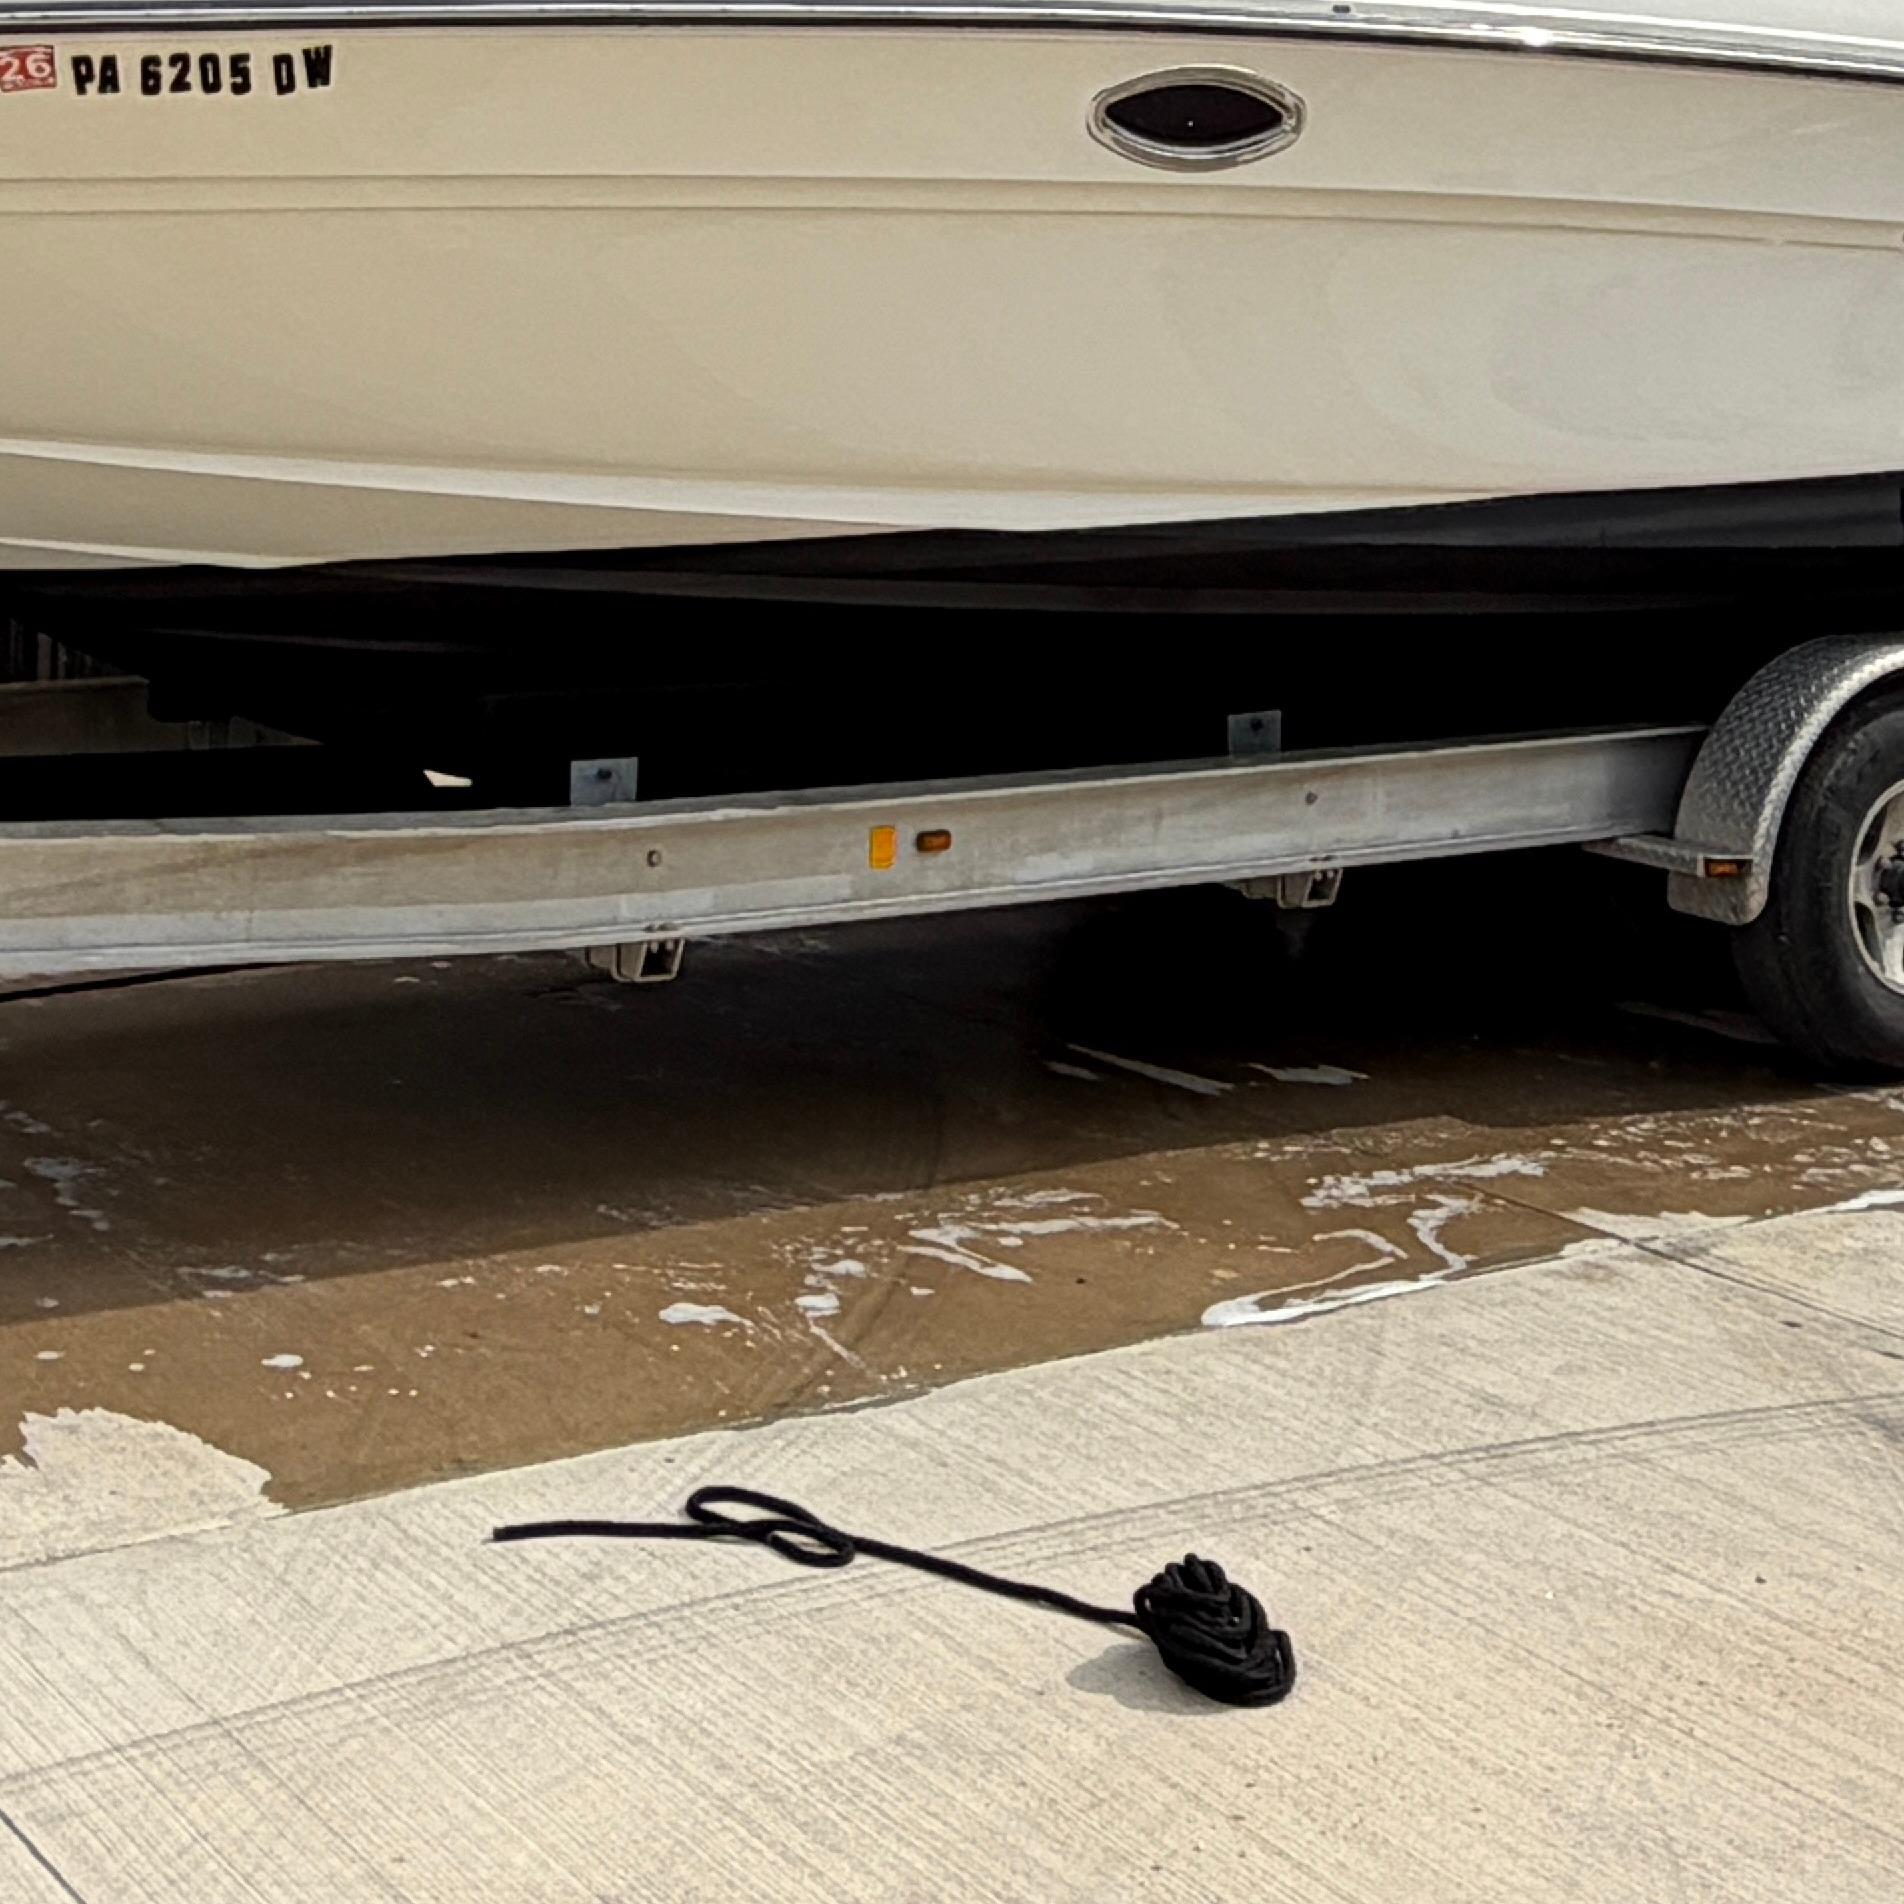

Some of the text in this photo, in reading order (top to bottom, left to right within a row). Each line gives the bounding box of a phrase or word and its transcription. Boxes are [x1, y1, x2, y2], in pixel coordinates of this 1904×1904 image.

[72, 45, 332, 95] PA 6205 DW
